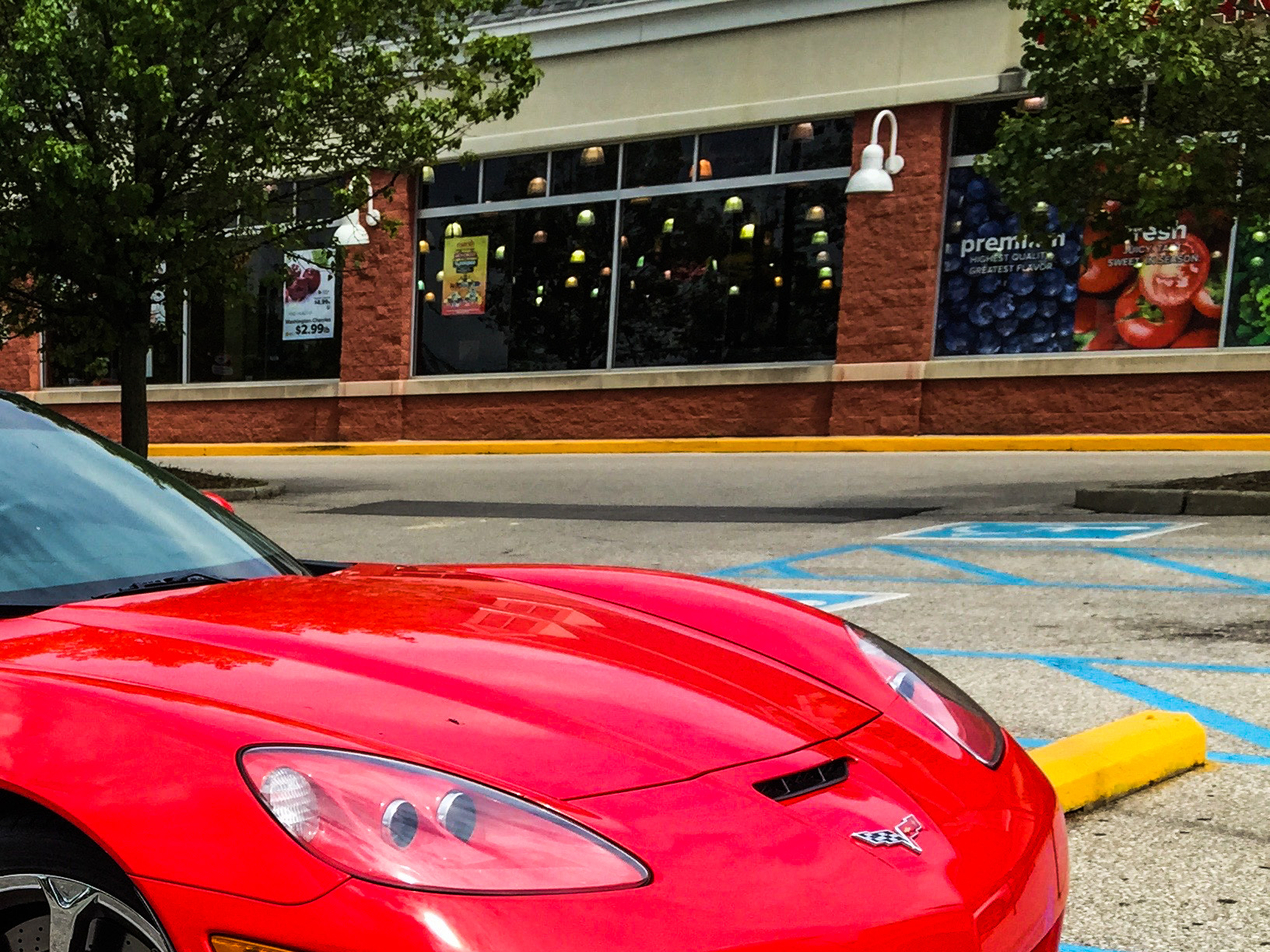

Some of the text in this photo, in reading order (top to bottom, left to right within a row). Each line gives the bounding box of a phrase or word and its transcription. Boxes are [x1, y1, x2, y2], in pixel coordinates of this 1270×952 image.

[1125, 220, 1187, 241] resh
[960, 232, 1066, 258] premim
[969, 264, 1014, 275] GREATEST
